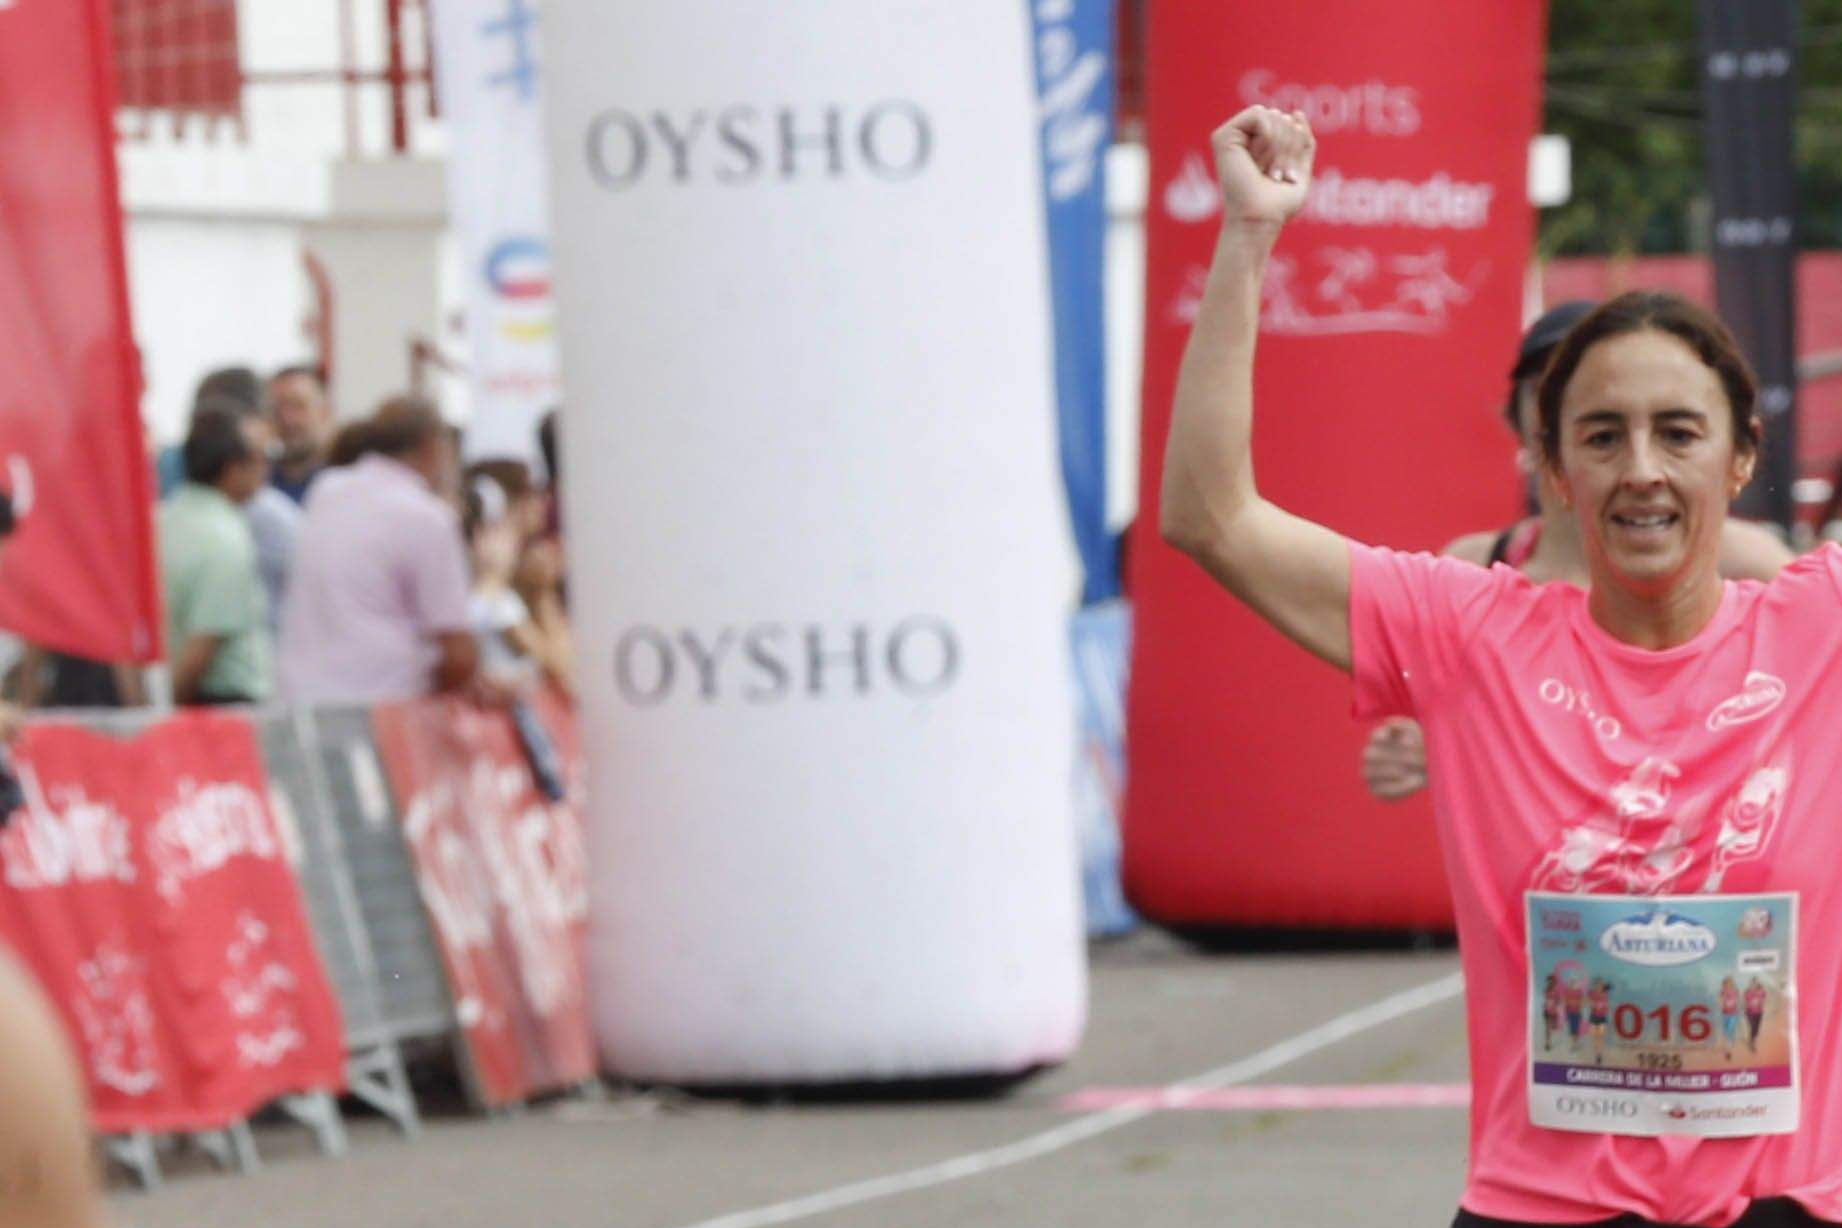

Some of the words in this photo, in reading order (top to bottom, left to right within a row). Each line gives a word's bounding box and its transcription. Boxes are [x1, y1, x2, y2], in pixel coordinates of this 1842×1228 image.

[584, 99, 936, 193] OYSHO
[1303, 168, 1494, 230] tander
[613, 613, 962, 709] OYSHO
[1613, 1003, 1712, 1042] 016
[1556, 1096, 1638, 1119] OYSHO
[1689, 1104, 1767, 1122] Santander
